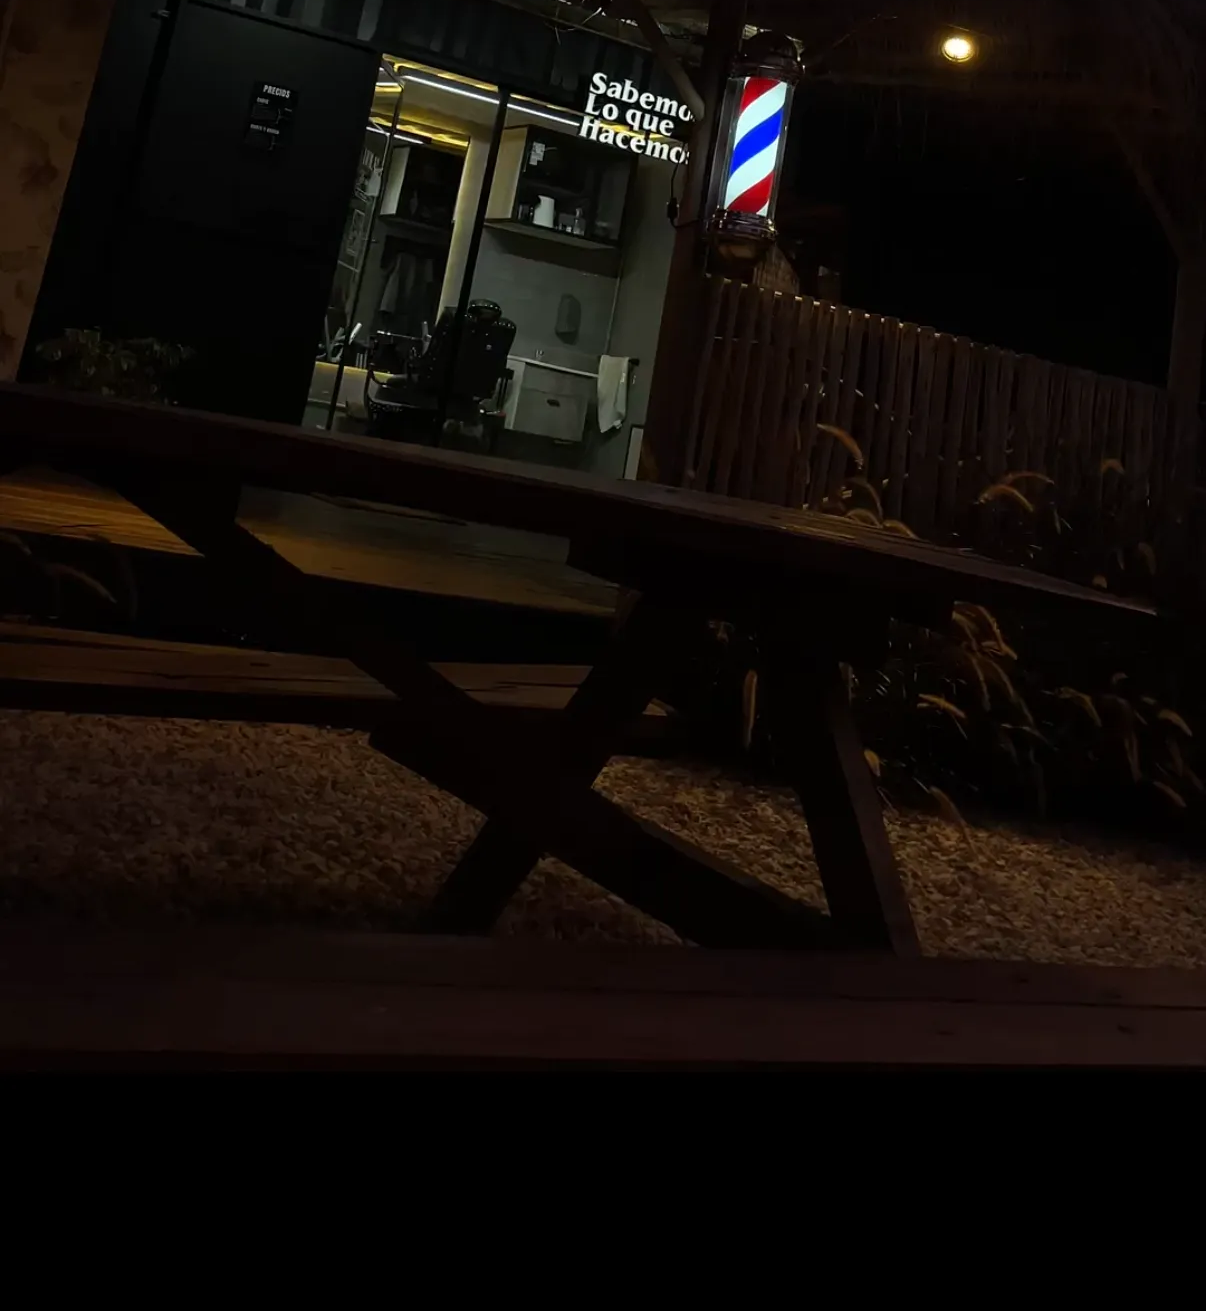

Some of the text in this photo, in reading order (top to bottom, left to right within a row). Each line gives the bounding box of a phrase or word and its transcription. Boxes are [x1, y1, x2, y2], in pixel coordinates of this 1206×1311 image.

[262, 84, 292, 99] PRECIOS
[589, 71, 696, 122] Sabemo
[584, 92, 675, 136] Lo que
